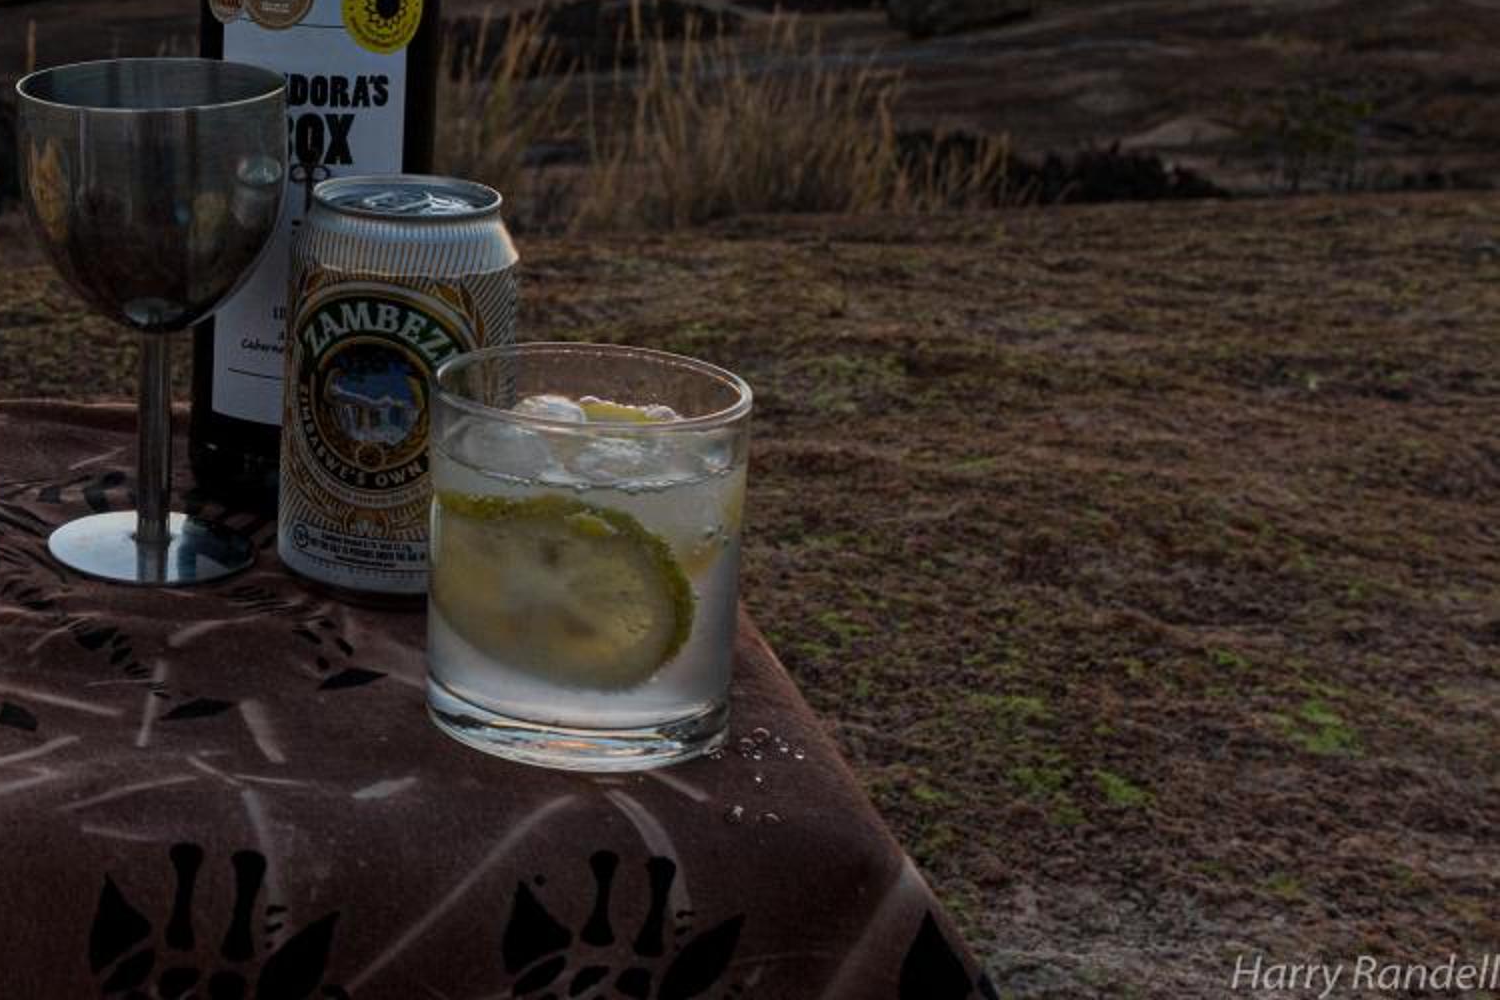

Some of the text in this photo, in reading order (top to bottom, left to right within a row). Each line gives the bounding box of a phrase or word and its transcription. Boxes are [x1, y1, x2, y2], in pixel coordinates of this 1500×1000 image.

[285, 73, 389, 108] DORA'S
[288, 113, 355, 164] OX
[375, 461, 423, 487] OWN
